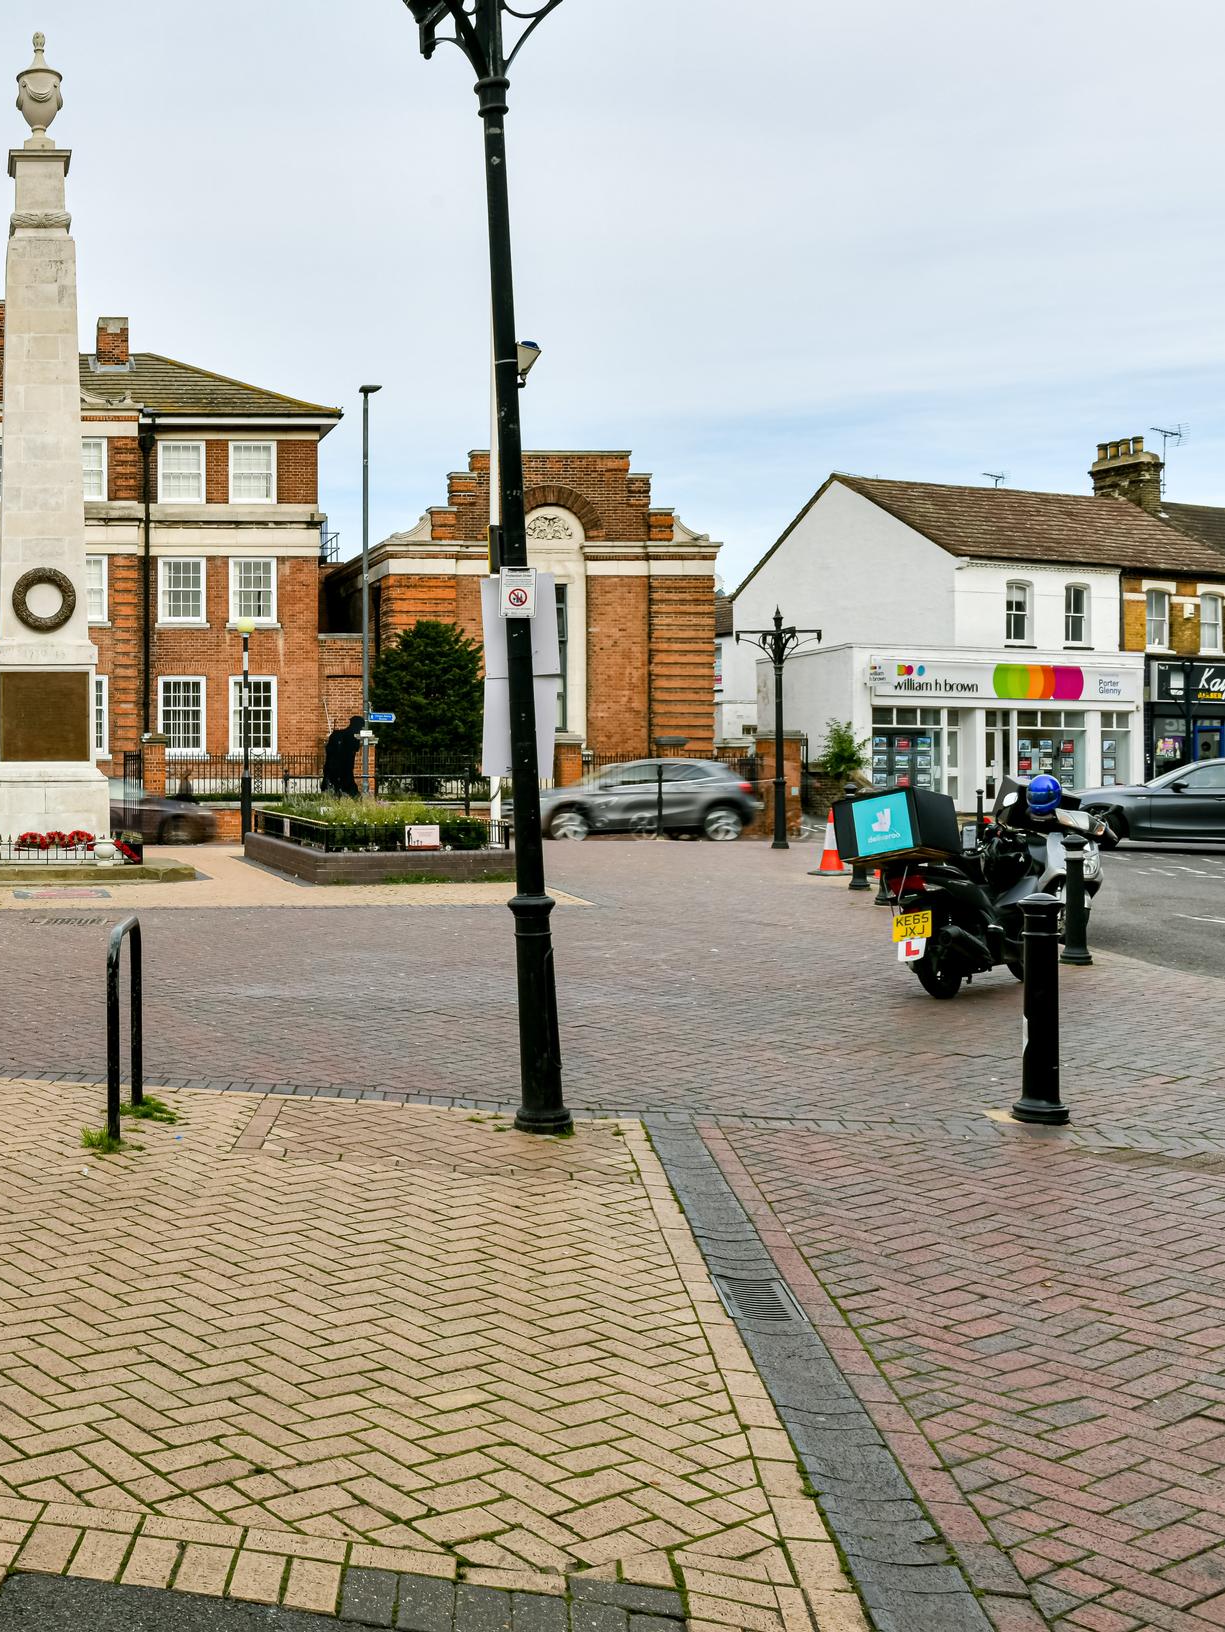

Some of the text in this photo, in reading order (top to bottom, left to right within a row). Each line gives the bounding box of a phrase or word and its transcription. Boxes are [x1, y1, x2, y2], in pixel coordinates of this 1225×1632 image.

[894, 678, 979, 693] william h brown
[1098, 679, 1119, 687] Porter
[1098, 686, 1122, 696] Glenny
[895, 912, 929, 927] KE65
[900, 925, 925, 938] JXJ
[905, 940, 920, 957] L
